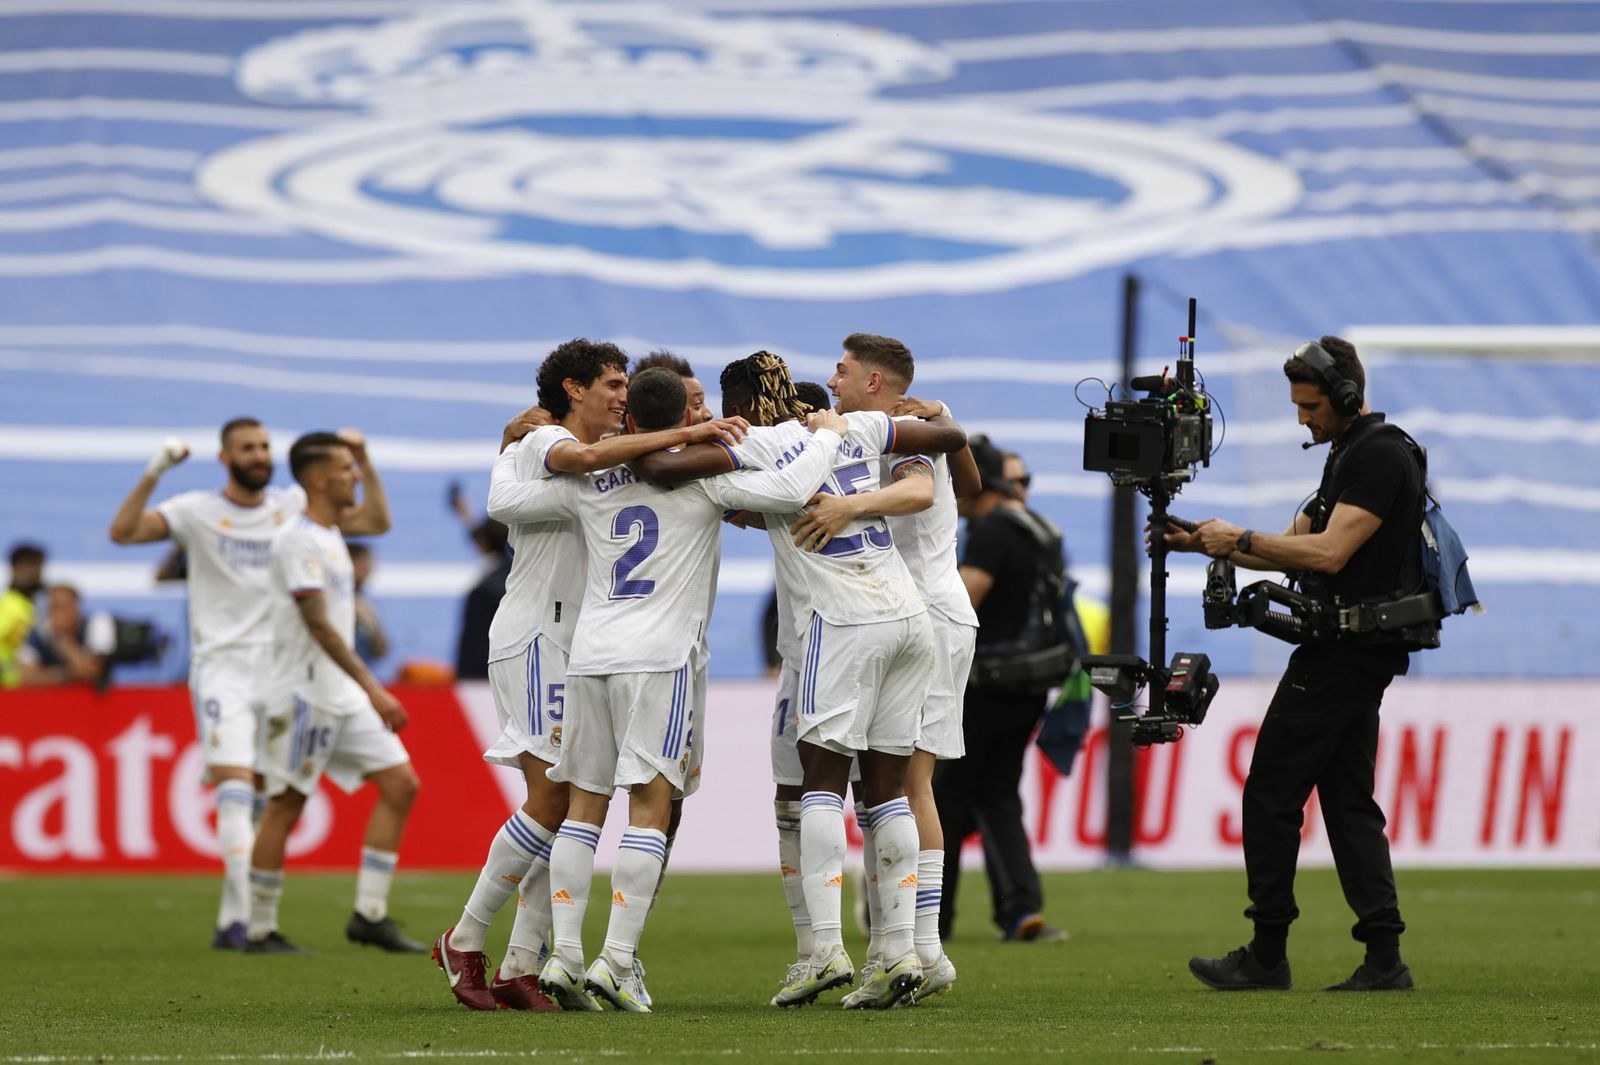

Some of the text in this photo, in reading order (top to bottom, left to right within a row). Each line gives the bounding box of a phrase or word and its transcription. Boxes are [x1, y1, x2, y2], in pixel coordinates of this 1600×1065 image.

[608, 505, 660, 601] 2
[205, 698, 221, 723] 9
[547, 683, 565, 721] 5
[0, 711, 335, 862] ate
[1216, 724, 1447, 848] SN
[1478, 724, 1573, 848] IN
